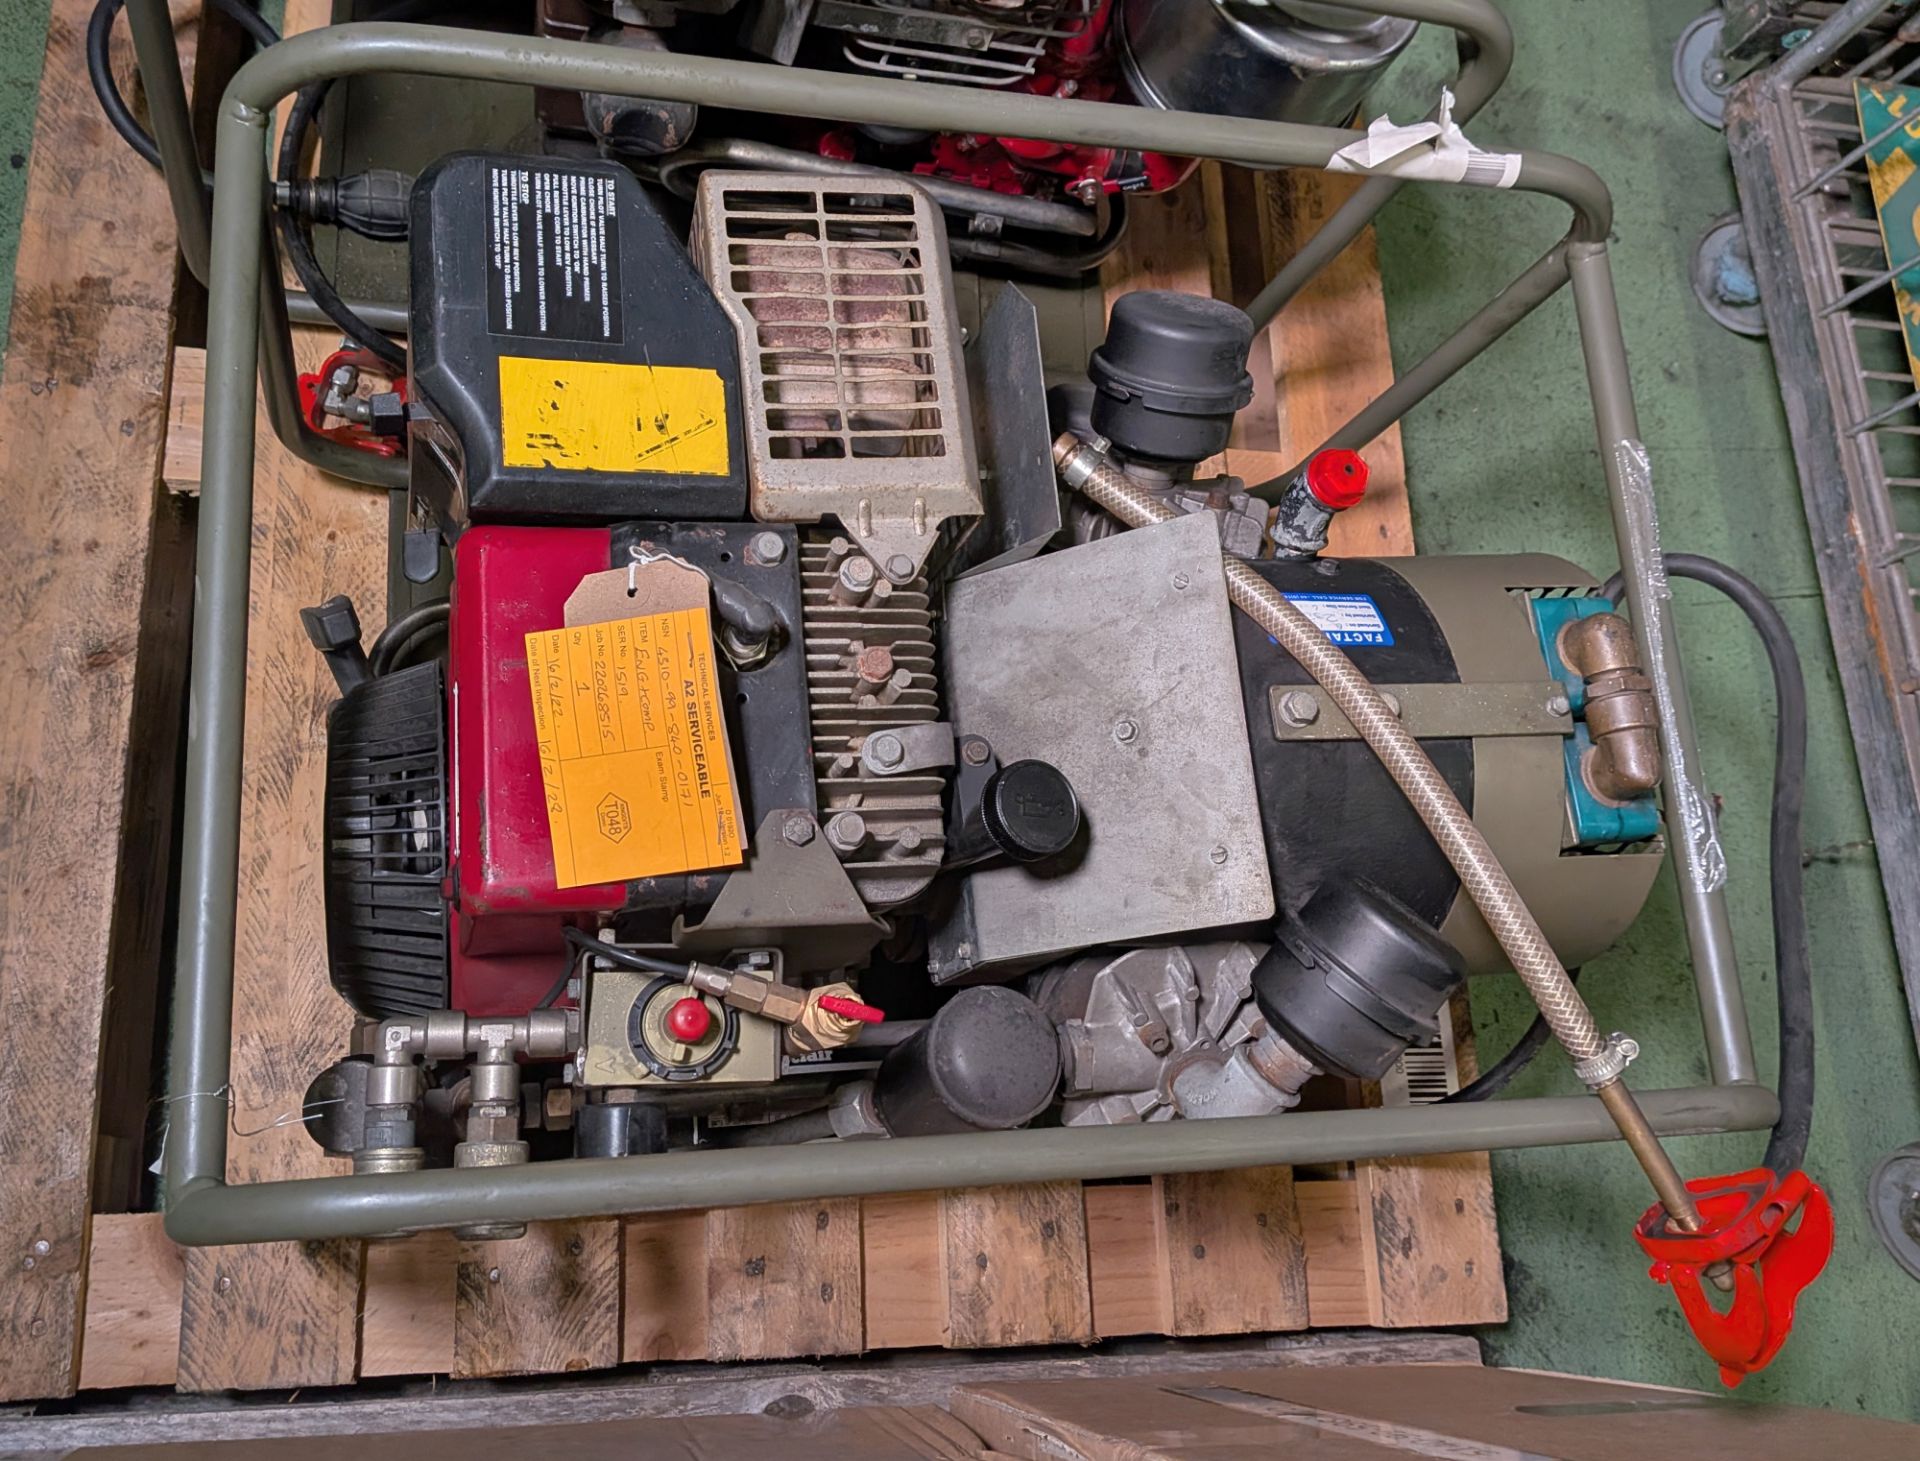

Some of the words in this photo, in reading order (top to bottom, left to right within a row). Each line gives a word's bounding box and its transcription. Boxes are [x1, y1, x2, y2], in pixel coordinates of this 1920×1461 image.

[521, 171, 528, 182] TO
[607, 179, 614, 190] TO
[512, 222, 518, 232] TO
[563, 227, 570, 236] TO
[494, 243, 500, 252] TO
[555, 235, 561, 245] TO
[573, 250, 579, 259] TO
[504, 264, 510, 274] TO
[538, 267, 544, 276] TO
[601, 272, 607, 281] TO
[595, 628, 603, 643] Job
[616, 625, 626, 643] SER
[638, 621, 649, 643] ITEM
[660, 618, 670, 638] NSN
[529, 638, 538, 657] Date
[551, 635, 561, 654] Date
[572, 631, 583, 646] Qty
[531, 658, 540, 667] of
[532, 668, 543, 688] Next
[697, 653, 711, 698] TECHNICAL
[683, 679, 695, 698] A2
[534, 688, 548, 730] Inspection
[703, 701, 716, 741] SERVICES
[686, 701, 711, 799] SERVICEABLE
[655, 751, 666, 774] Exam
[658, 776, 670, 803] Stamp
[604, 800, 622, 836] T048
